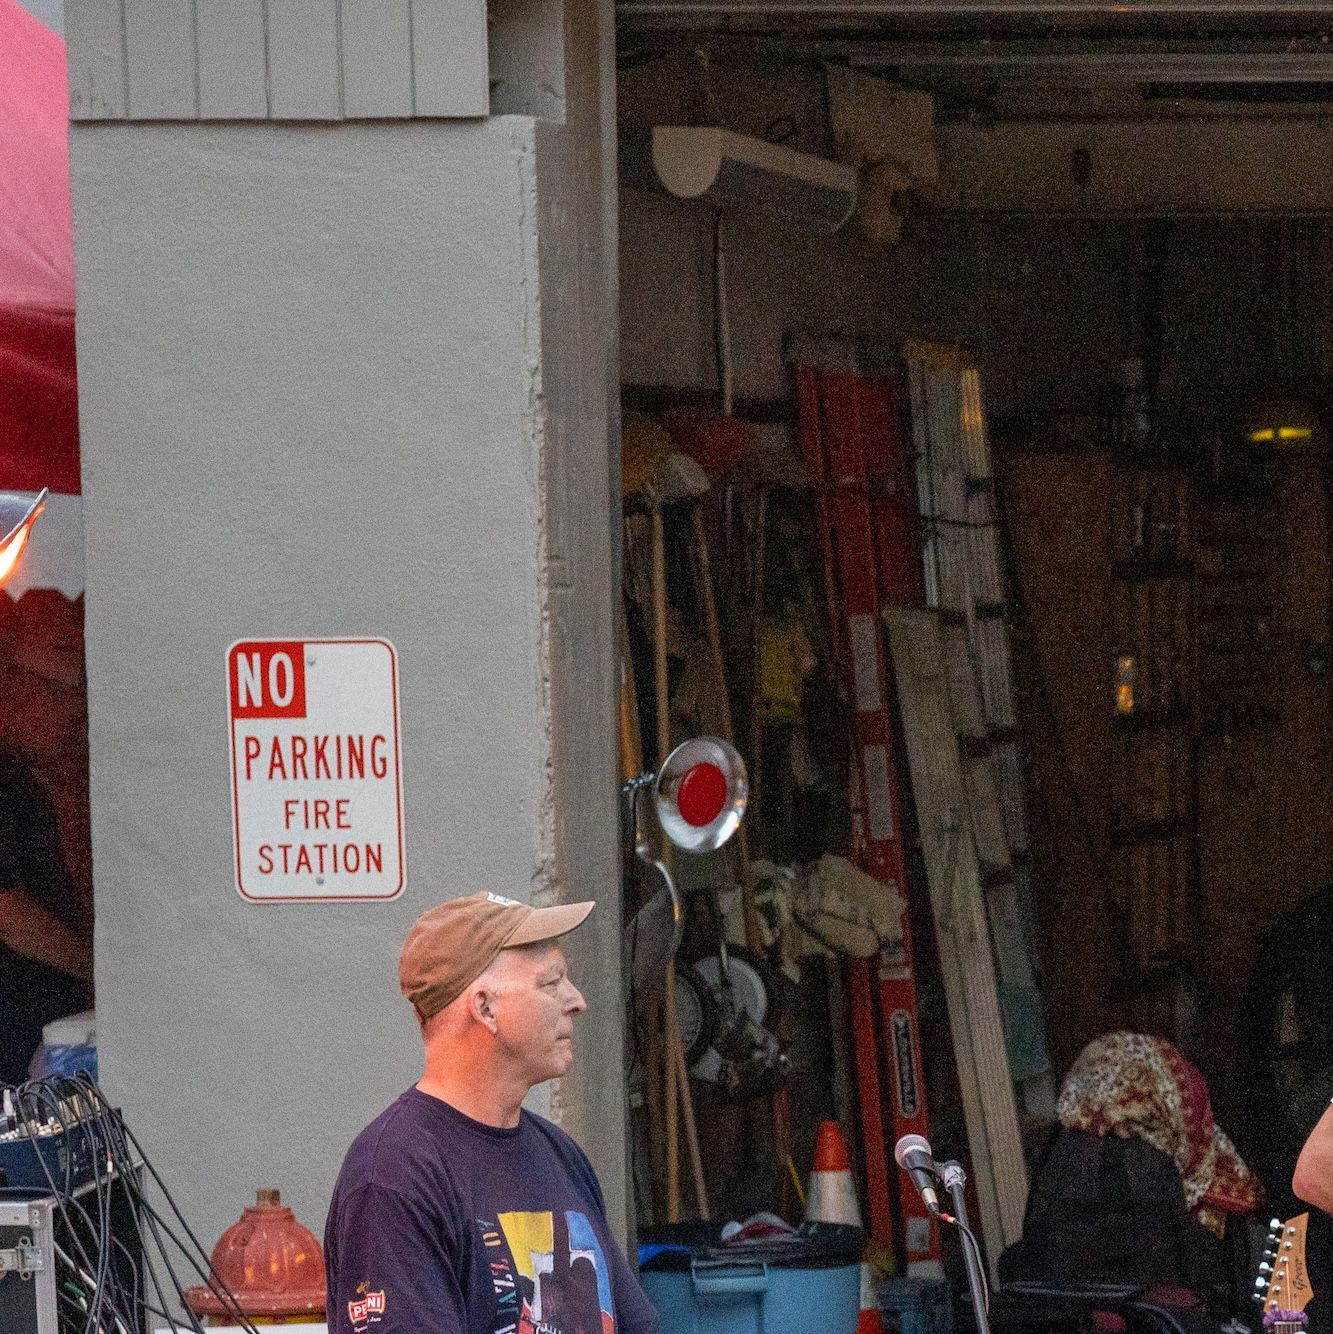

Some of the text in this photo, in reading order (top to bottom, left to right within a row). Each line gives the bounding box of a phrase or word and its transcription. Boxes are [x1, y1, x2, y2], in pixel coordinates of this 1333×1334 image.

[237, 652, 294, 708] NO
[244, 734, 387, 780] PARKING
[284, 799, 351, 830] FIRE
[258, 843, 383, 875] STATION
